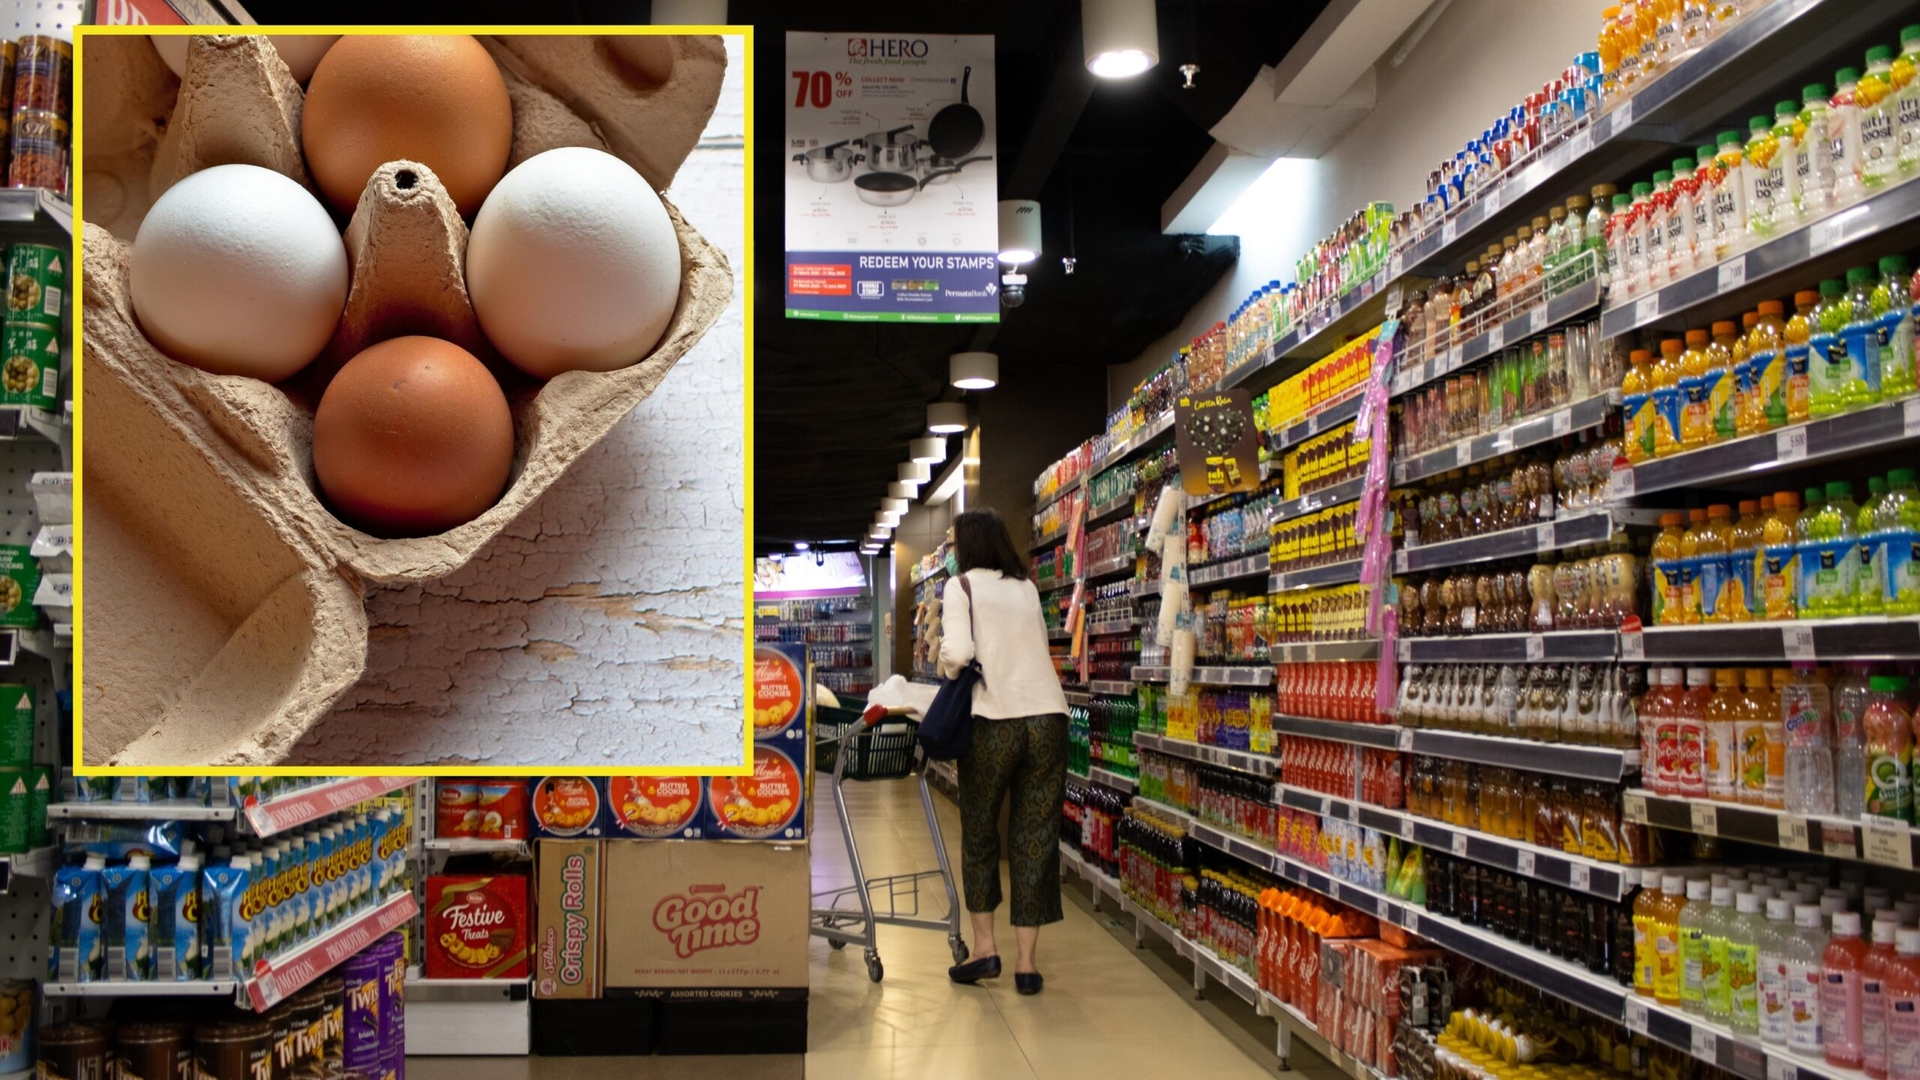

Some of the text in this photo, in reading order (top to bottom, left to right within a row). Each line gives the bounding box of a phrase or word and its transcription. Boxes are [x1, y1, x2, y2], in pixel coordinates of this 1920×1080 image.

[870, 39, 928, 58] HERO
[849, 58, 928, 66] The fresh food people
[792, 71, 853, 109] 70 %
[836, 89, 853, 98] OFF
[860, 255, 995, 270] REDEEM YOUR STAMPS
[945, 289, 988, 297] PermataBank
[326, 783, 373, 807] PROMOTION
[656, 788, 690, 796] COOKIES
[757, 788, 791, 796] COOKIES
[377, 900, 413, 930] PROMOTION
[442, 904, 506, 930] Festive
[654, 886, 758, 932] Good
[560, 855, 588, 985] Crispy Rolls
[461, 928, 490, 941] Treats
[669, 918, 759, 958] Time
[326, 927, 370, 963] PROMOTION
[670, 990, 743, 998] ASSORTED COOKIES
